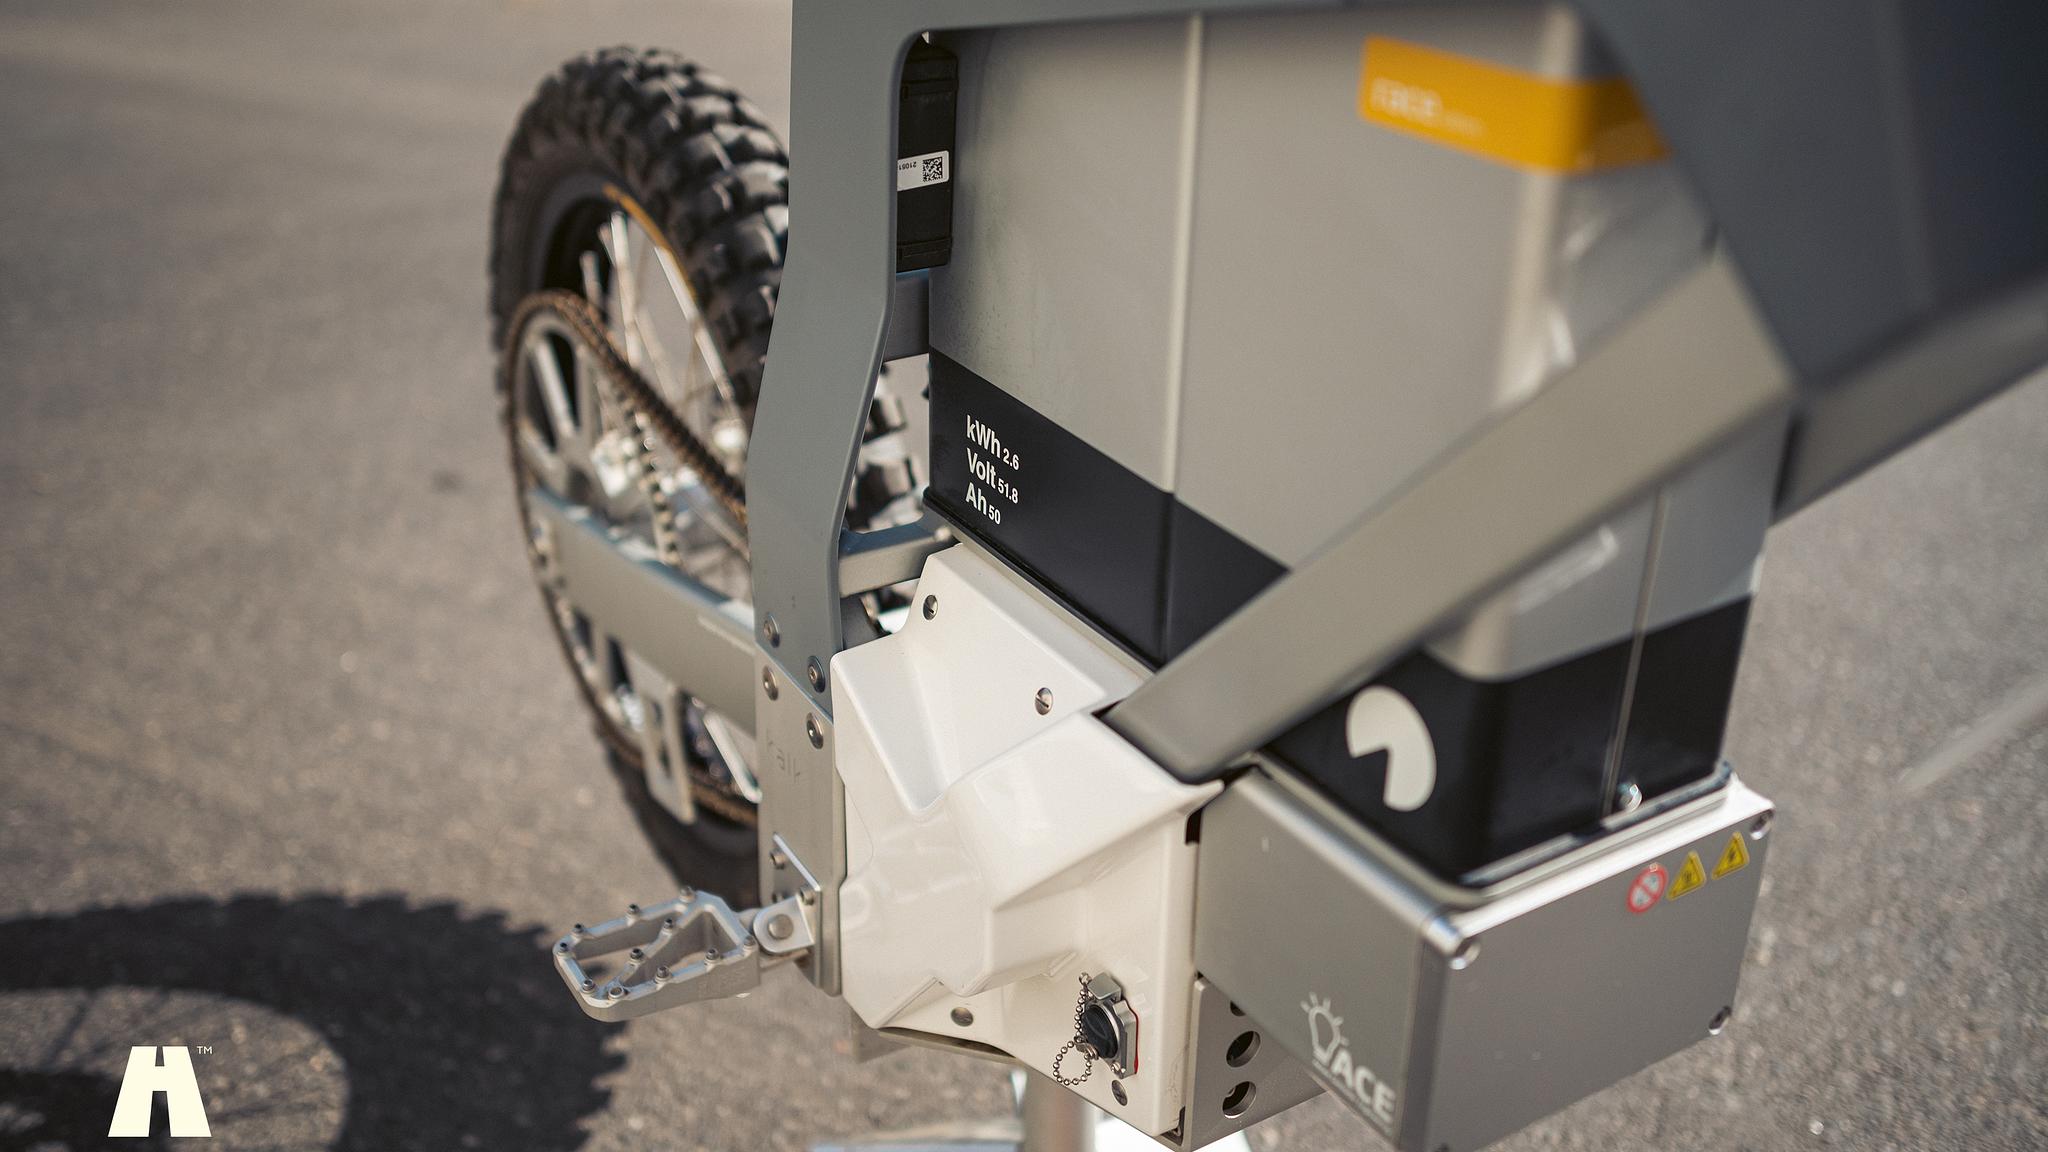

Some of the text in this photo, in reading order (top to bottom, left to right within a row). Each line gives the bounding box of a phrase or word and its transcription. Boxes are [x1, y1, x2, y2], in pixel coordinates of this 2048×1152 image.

[966, 414, 1020, 471] kWh 2.6
[965, 482, 1001, 525] Ah 50
[966, 447, 1019, 504] Volt 51.8
